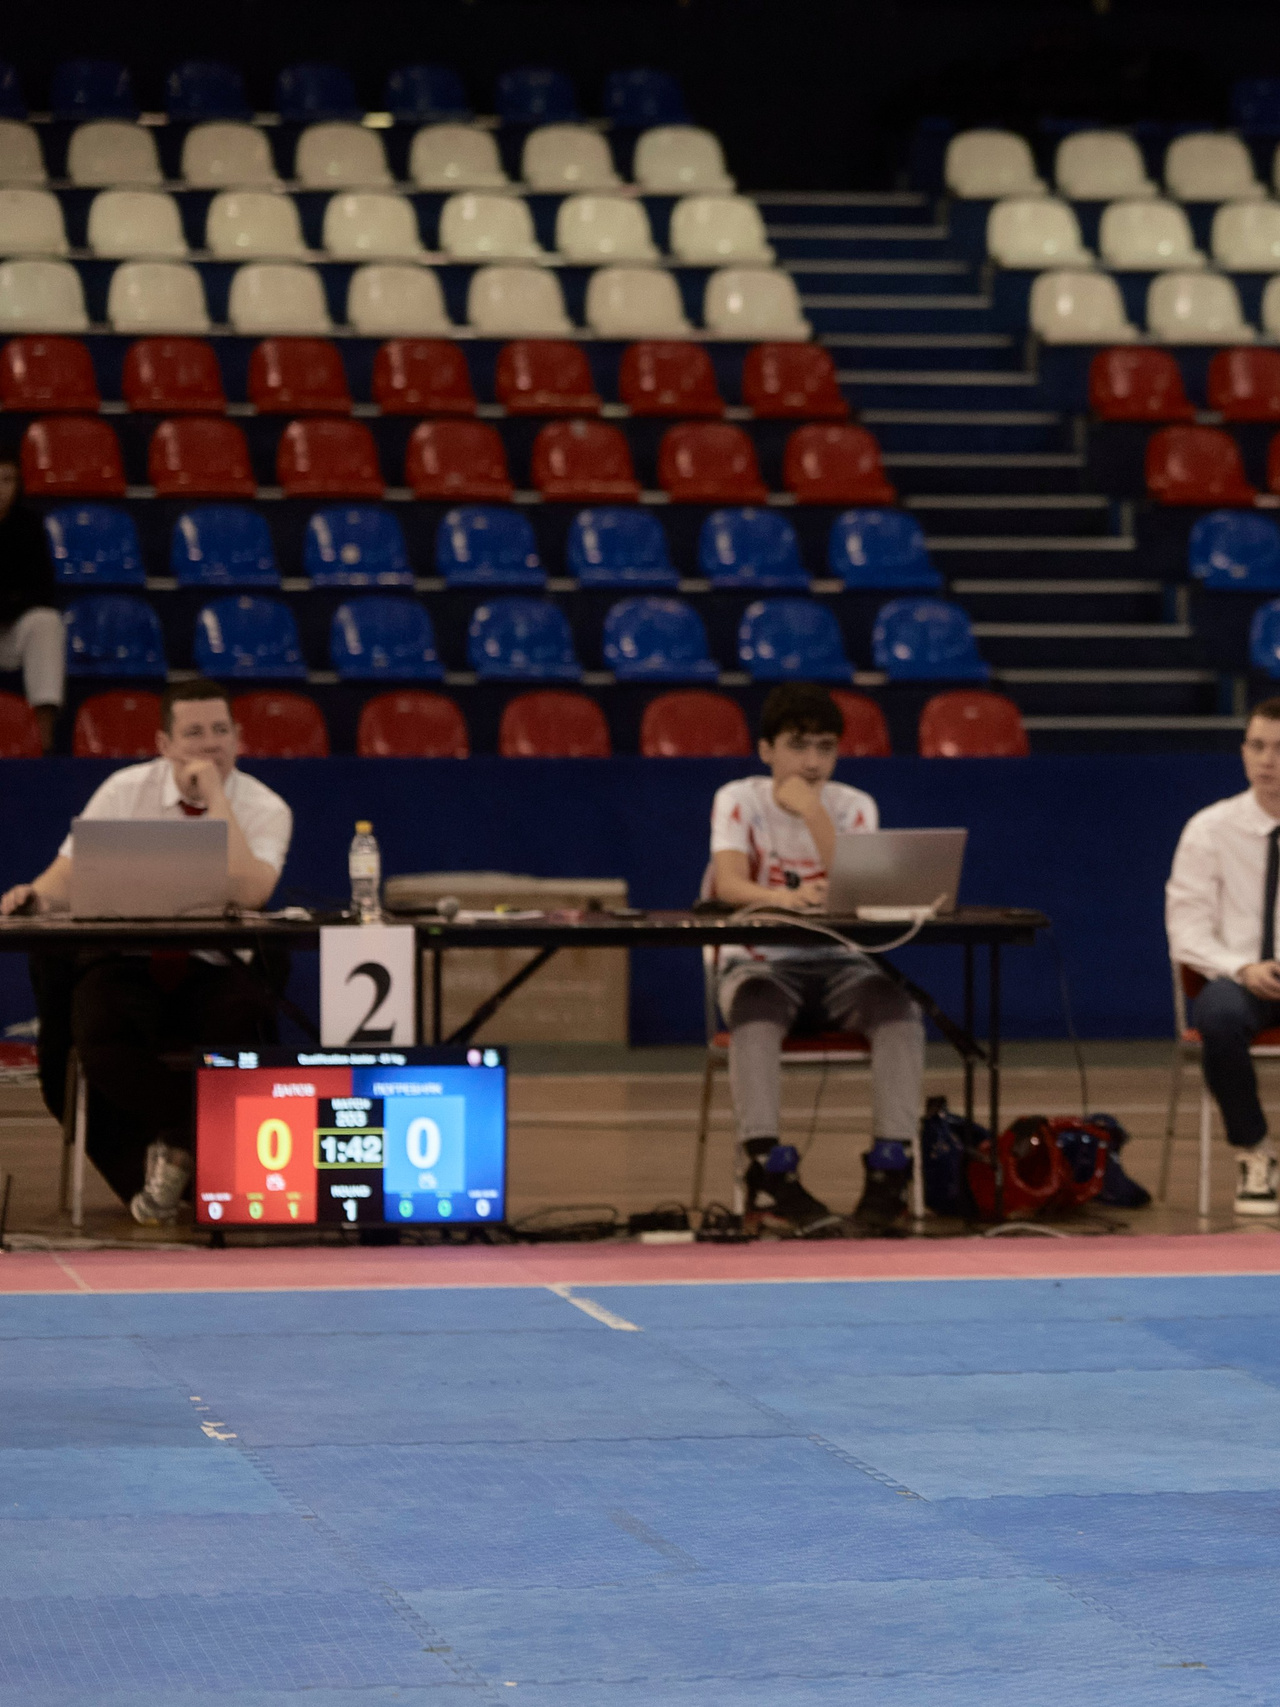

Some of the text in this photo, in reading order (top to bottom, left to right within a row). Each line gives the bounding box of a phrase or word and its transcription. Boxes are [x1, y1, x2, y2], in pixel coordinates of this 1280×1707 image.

[345, 962, 396, 1044] 2
[256, 1118, 293, 1170] 0
[320, 1135, 383, 1164] 1:42
[406, 1117, 441, 1169] 0
[208, 1202, 223, 1220] 0
[249, 1201, 264, 1219] 0
[342, 1199, 358, 1222] 1
[475, 1199, 491, 1217] 0
